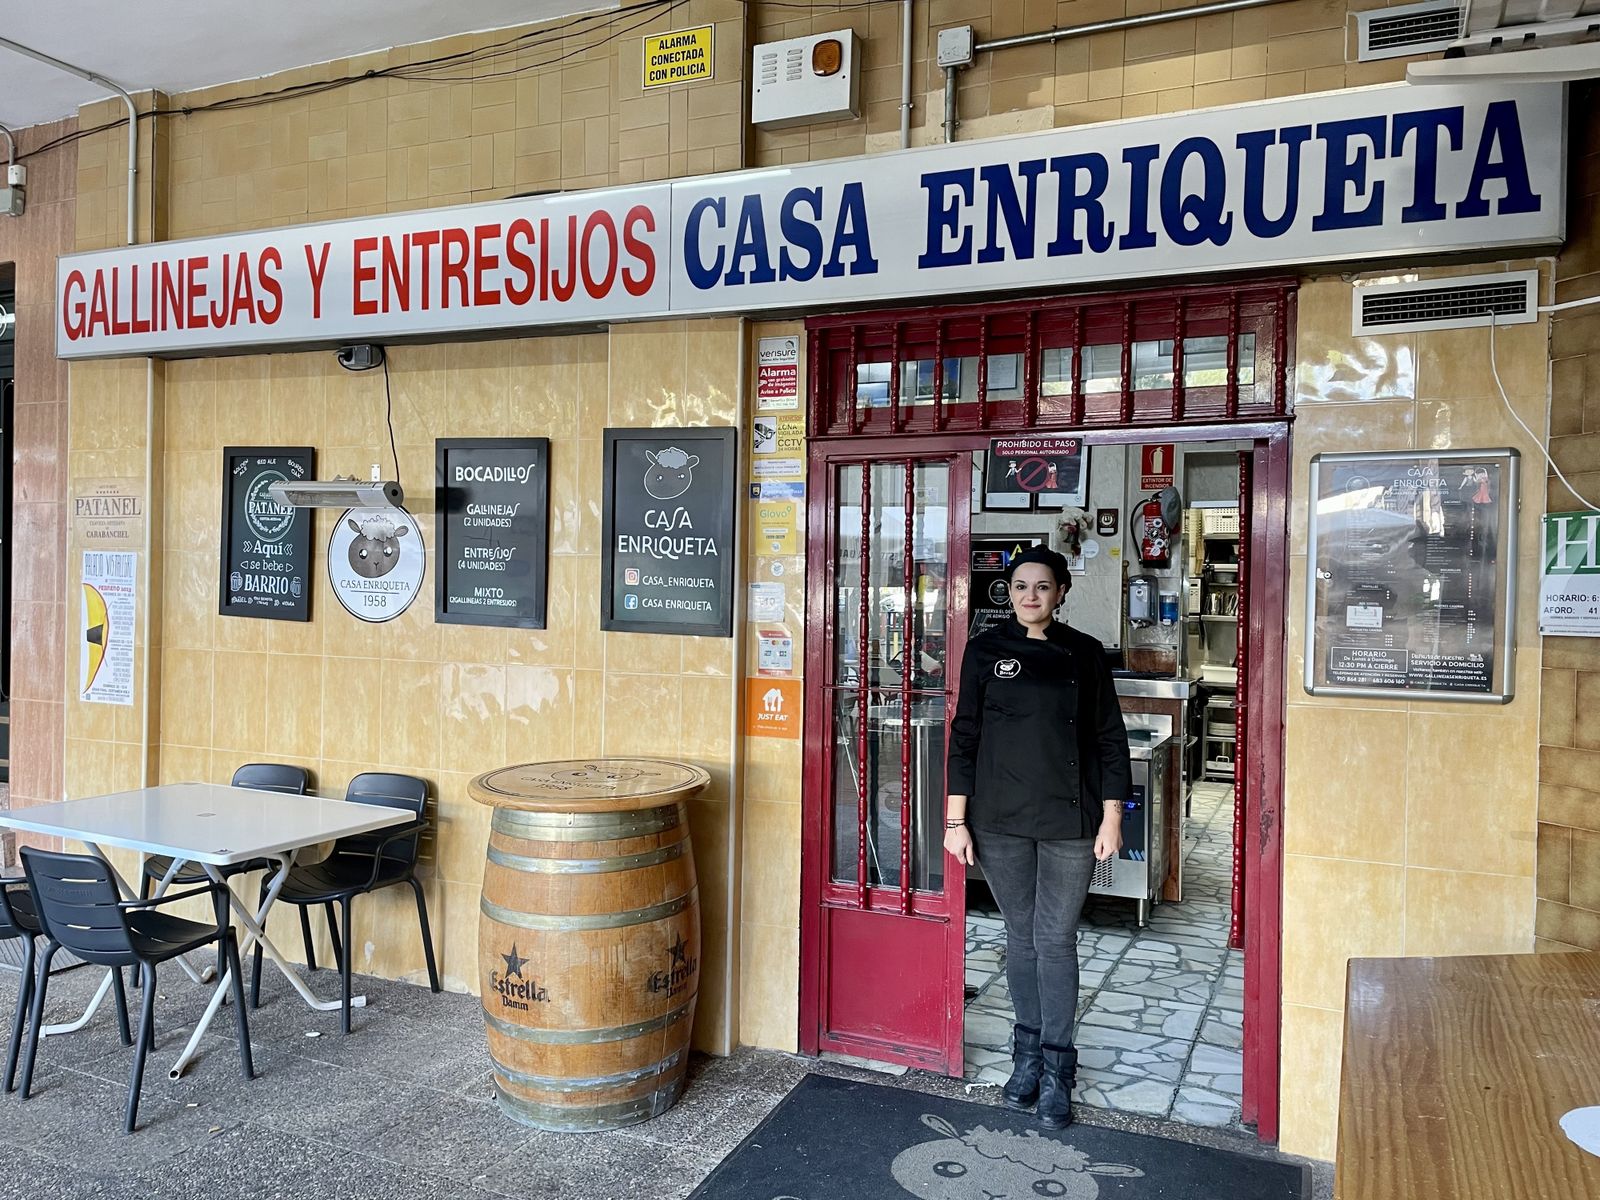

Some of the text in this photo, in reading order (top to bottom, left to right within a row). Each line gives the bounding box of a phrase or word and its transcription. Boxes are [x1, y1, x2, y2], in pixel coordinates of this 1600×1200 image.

[659, 34, 697, 51] ALARMA
[651, 48, 704, 66] CONECTADA
[649, 62, 706, 82] CON POLICIA
[684, 100, 1541, 290] CASA ENRIQUETA
[63, 204, 656, 341] GALLINEJAS Y ENTRESIJOS
[760, 349, 796, 358] verisure
[760, 367, 796, 377] Alarma
[778, 438, 802, 446] CCTV
[997, 440, 1041, 448] PROHIBIDO
[1055, 440, 1076, 448] PASO
[455, 464, 535, 484] BOCADILLOS
[1408, 466, 1434, 478] CASA
[1394, 478, 1447, 489] ENRIQUETA
[75, 498, 142, 516] PATANEL
[466, 503, 521, 517] GALLINEJAS
[464, 518, 512, 528] (2 UNIDADES)
[645, 507, 693, 531] CASA
[86, 530, 130, 538] CARABANCHEL
[252, 540, 283, 558] Aquí
[618, 535, 718, 560] ENRIQUETA
[1551, 515, 1600, 570] H
[464, 547, 516, 561] ENTRESIJOS
[250, 559, 284, 572] se bebe
[458, 560, 506, 571] (4 UNIDADES)
[244, 574, 289, 595] BARRIO
[340, 580, 410, 592] CASA ENRIQUETA
[642, 575, 715, 589] CASA_ENRIQUETA
[474, 586, 504, 598] MIXTO
[1546, 594, 1590, 602] HORARIO:
[363, 595, 387, 608] 1958
[642, 598, 712, 611] CASA ENRIQUETA
[1544, 606, 1576, 614] AFORO:
[1352, 650, 1386, 658] HORARIO
[489, 968, 549, 1002] Estrella
[502, 994, 529, 1011] Damm
